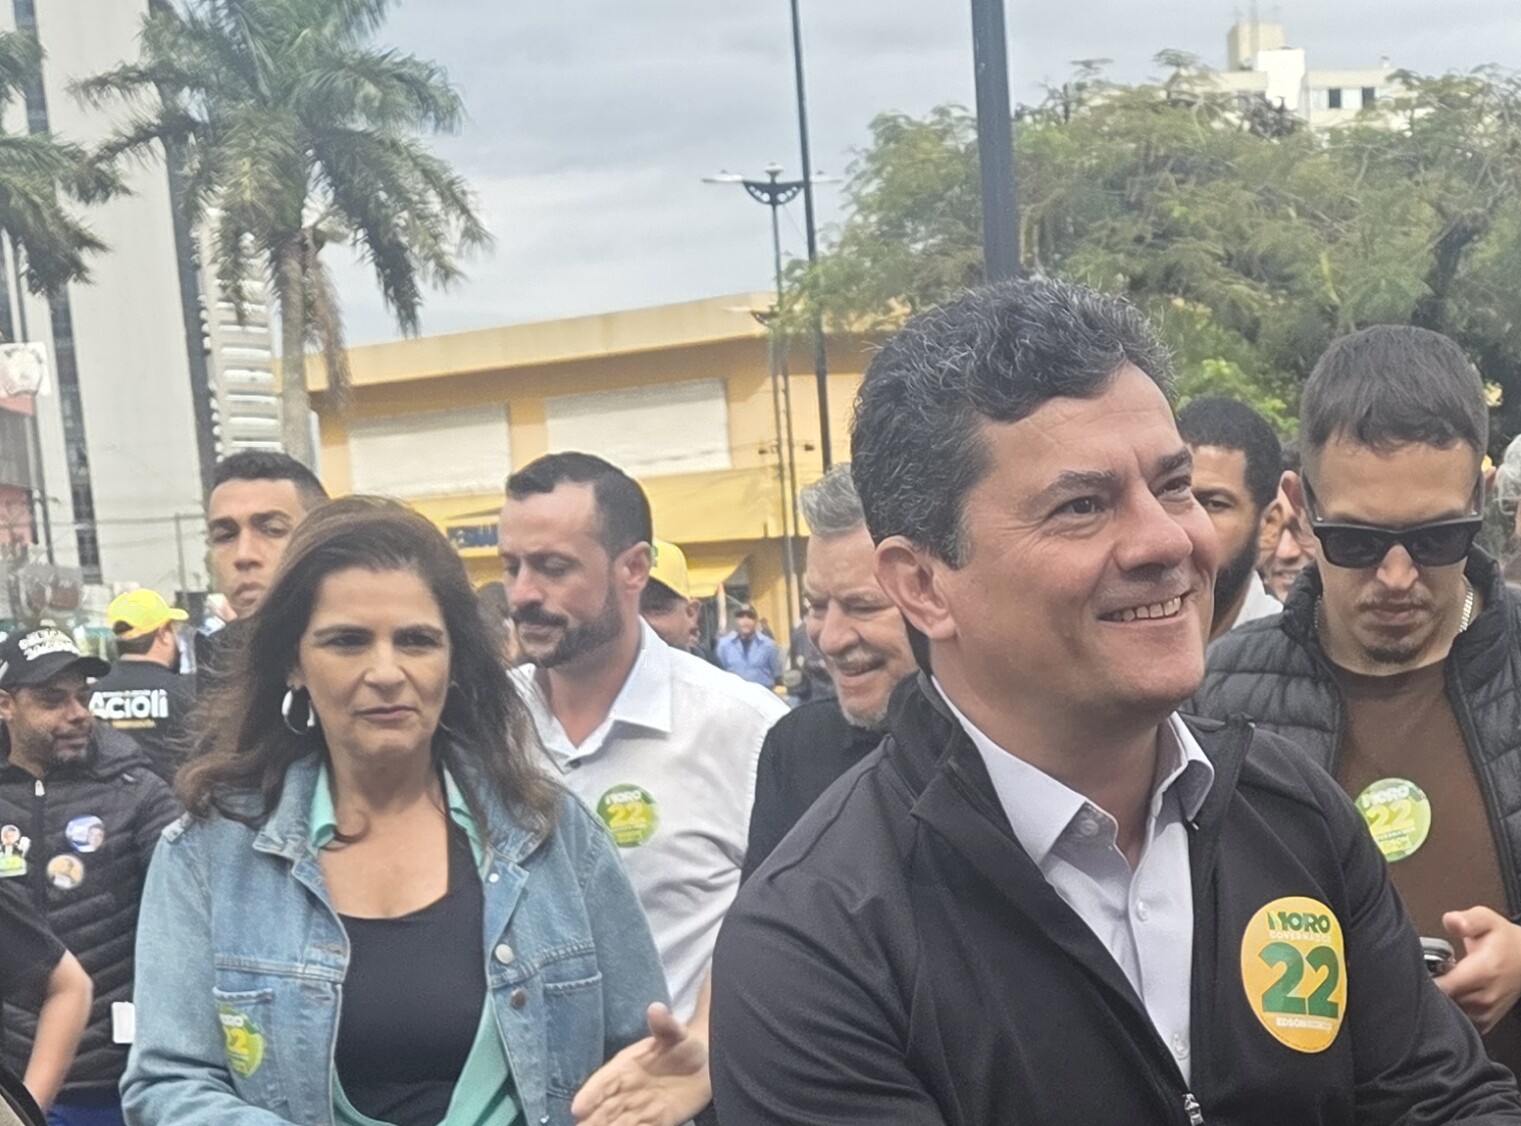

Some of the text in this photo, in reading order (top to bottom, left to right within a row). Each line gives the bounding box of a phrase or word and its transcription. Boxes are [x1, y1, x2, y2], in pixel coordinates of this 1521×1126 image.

[607, 802, 647, 828] 22
[1366, 800, 1416, 836] 22
[1267, 911, 1331, 934] MORO
[1258, 941, 1340, 1020] 22
